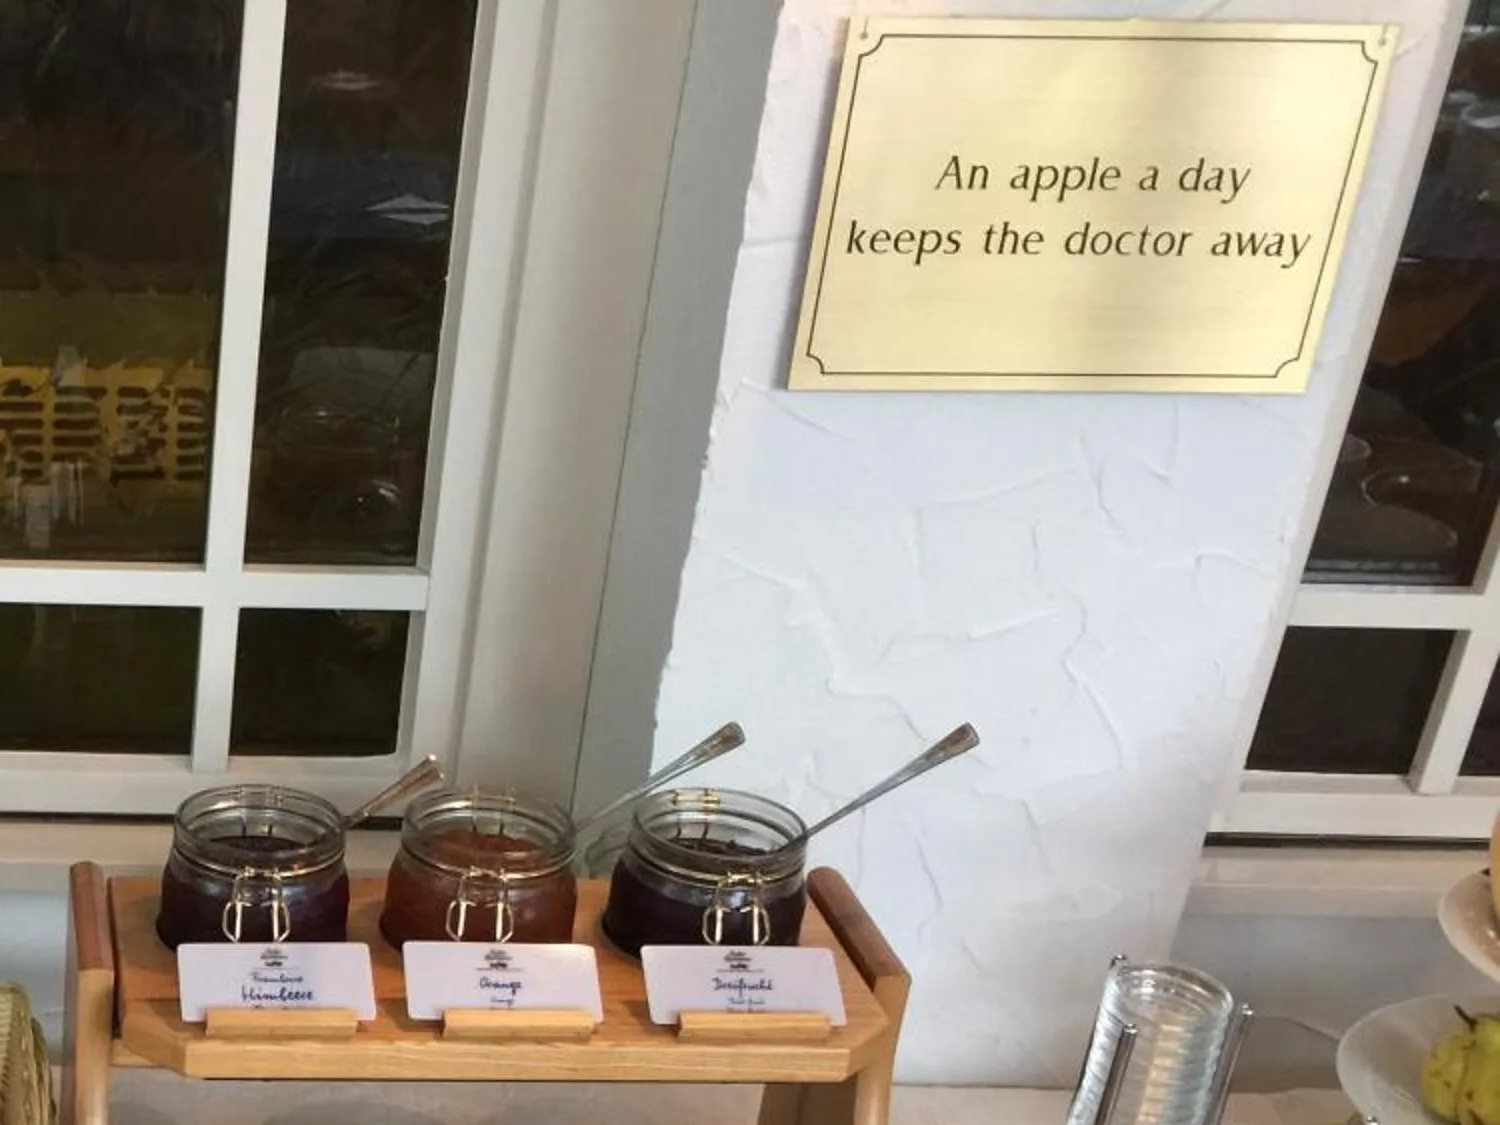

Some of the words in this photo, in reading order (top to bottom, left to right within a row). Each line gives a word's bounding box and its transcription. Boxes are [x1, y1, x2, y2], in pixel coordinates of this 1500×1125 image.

[935, 155, 989, 190] An
[1010, 157, 1121, 202] apple
[1139, 164, 1158, 191] a
[1179, 158, 1251, 204] day
[846, 220, 962, 265] keeps
[984, 222, 1044, 255] the
[1064, 222, 1193, 256] doctor
[1211, 233, 1311, 268] away
[479, 977, 522, 995] Orange
